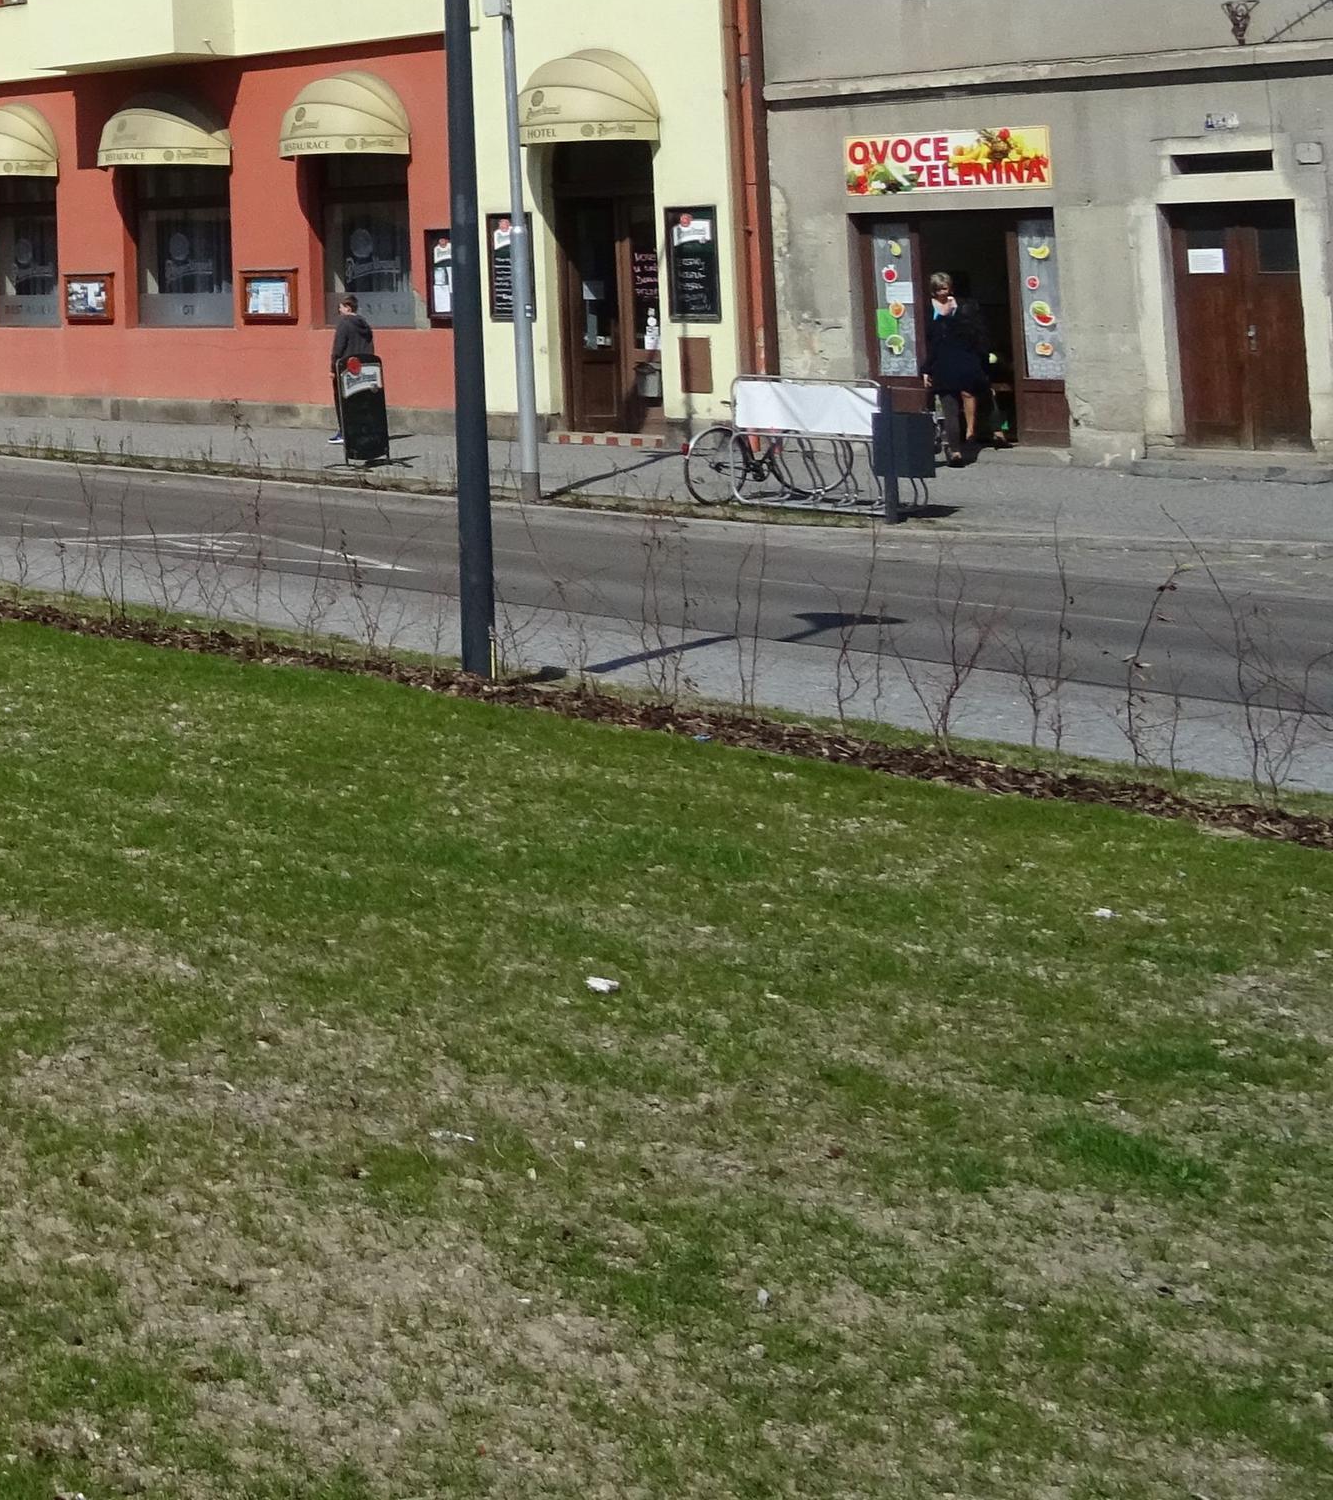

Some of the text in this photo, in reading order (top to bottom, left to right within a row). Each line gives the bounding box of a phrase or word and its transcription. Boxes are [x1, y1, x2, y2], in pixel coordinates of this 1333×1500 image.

[527, 128, 557, 139] HOTEL
[848, 137, 949, 165] OVOCE
[909, 160, 1048, 188] ZELENINA
